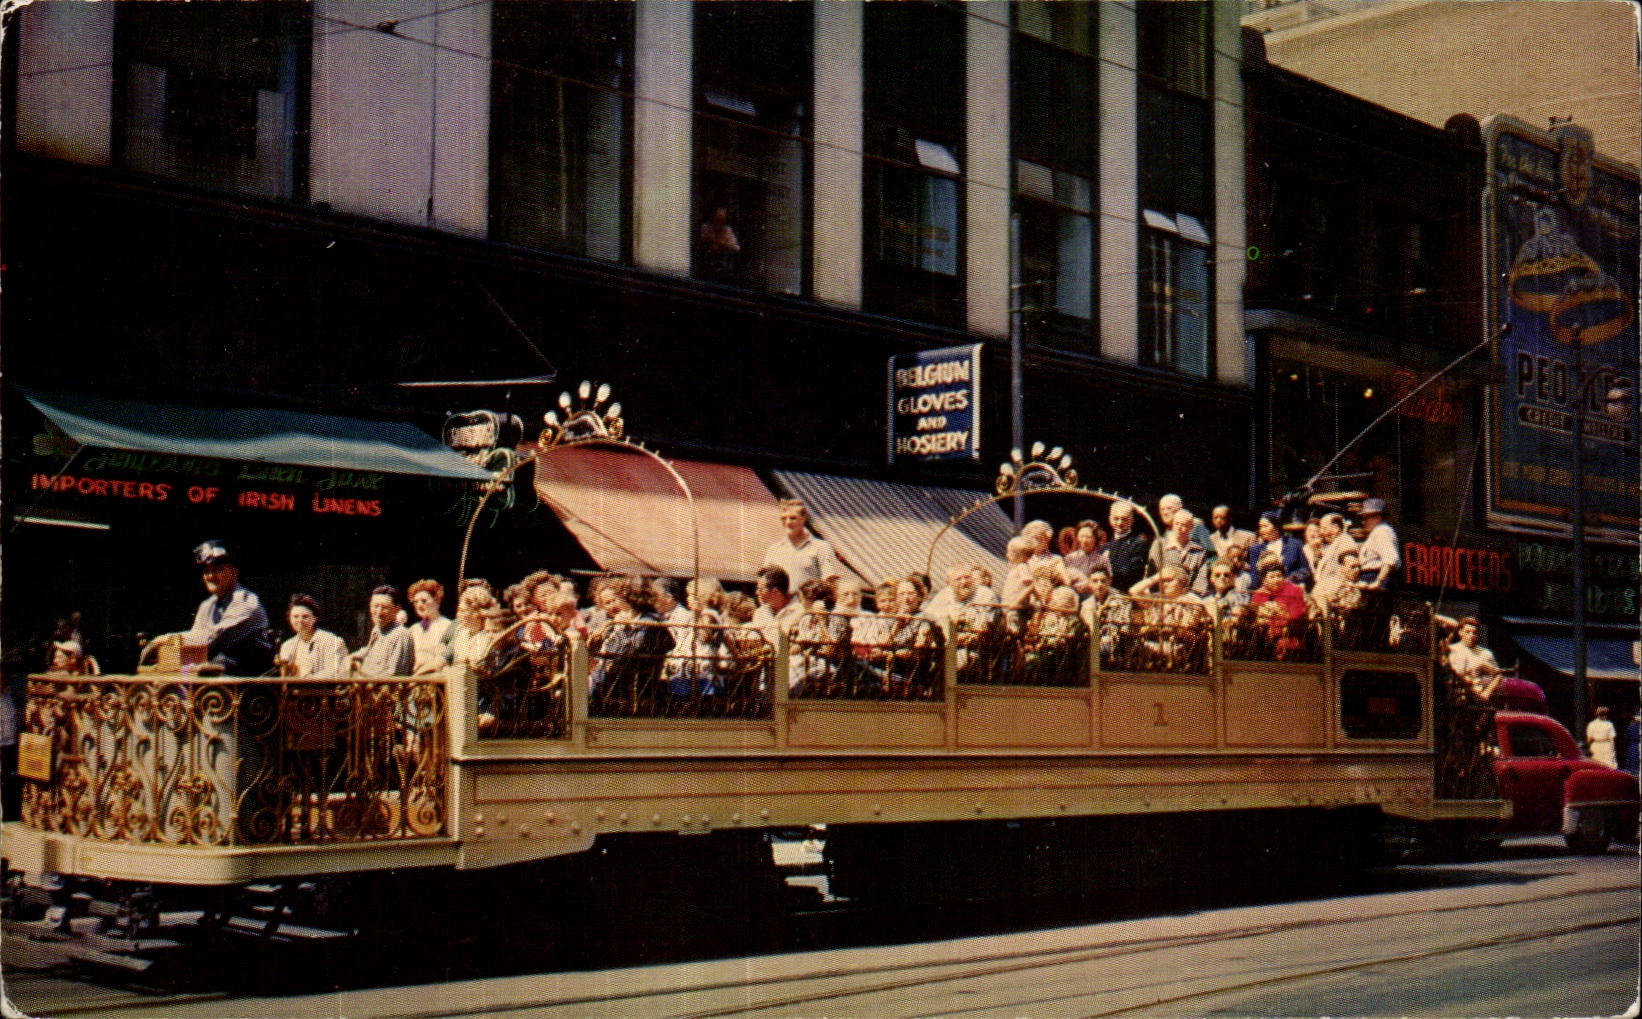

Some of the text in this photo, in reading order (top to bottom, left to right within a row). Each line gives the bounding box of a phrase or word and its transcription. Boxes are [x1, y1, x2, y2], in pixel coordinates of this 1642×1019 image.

[896, 360, 970, 388] BELGIUM
[897, 390, 969, 415] GLOVES
[916, 416, 947, 431] AND
[896, 431, 969, 454] HOSIERY
[31, 473, 383, 518] IMPORTERS OF IRISH LINENS
[1153, 702, 1168, 727] 1
